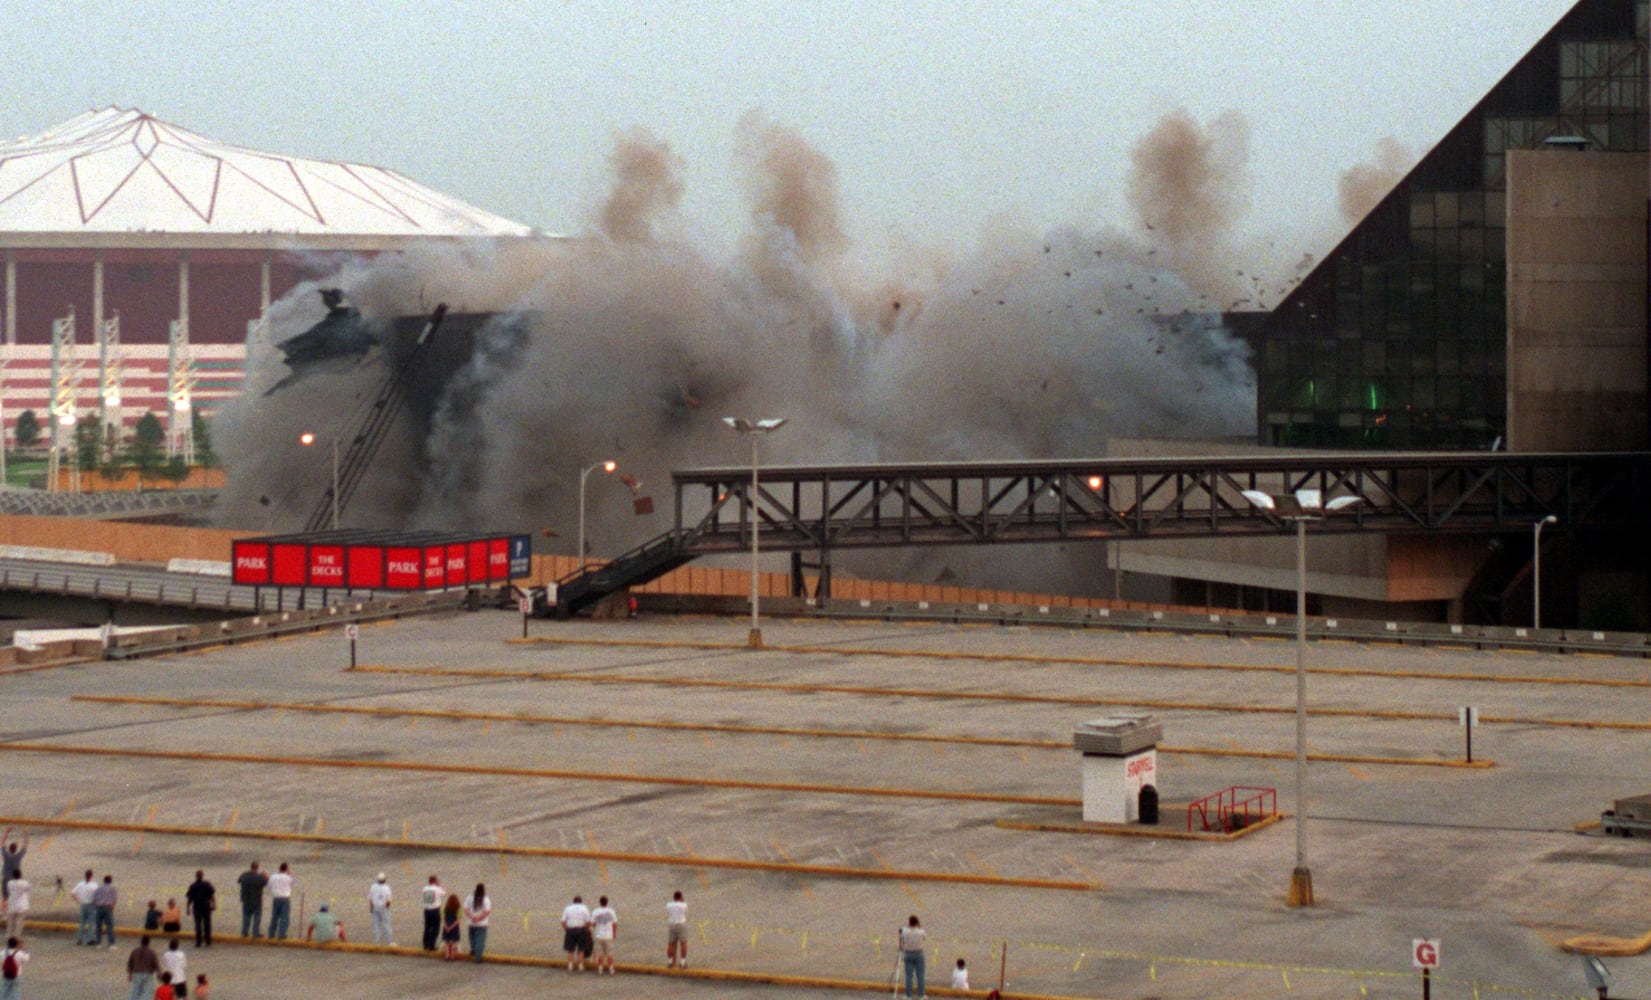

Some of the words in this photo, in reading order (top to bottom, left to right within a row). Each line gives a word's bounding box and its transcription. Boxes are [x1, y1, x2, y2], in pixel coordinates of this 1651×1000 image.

[237, 557, 267, 569] PARK
[318, 555, 335, 565] THE
[447, 558, 466, 571] PARK
[312, 566, 343, 577] DECKS
[388, 561, 419, 574] PARK
[1415, 943, 1436, 966] G
